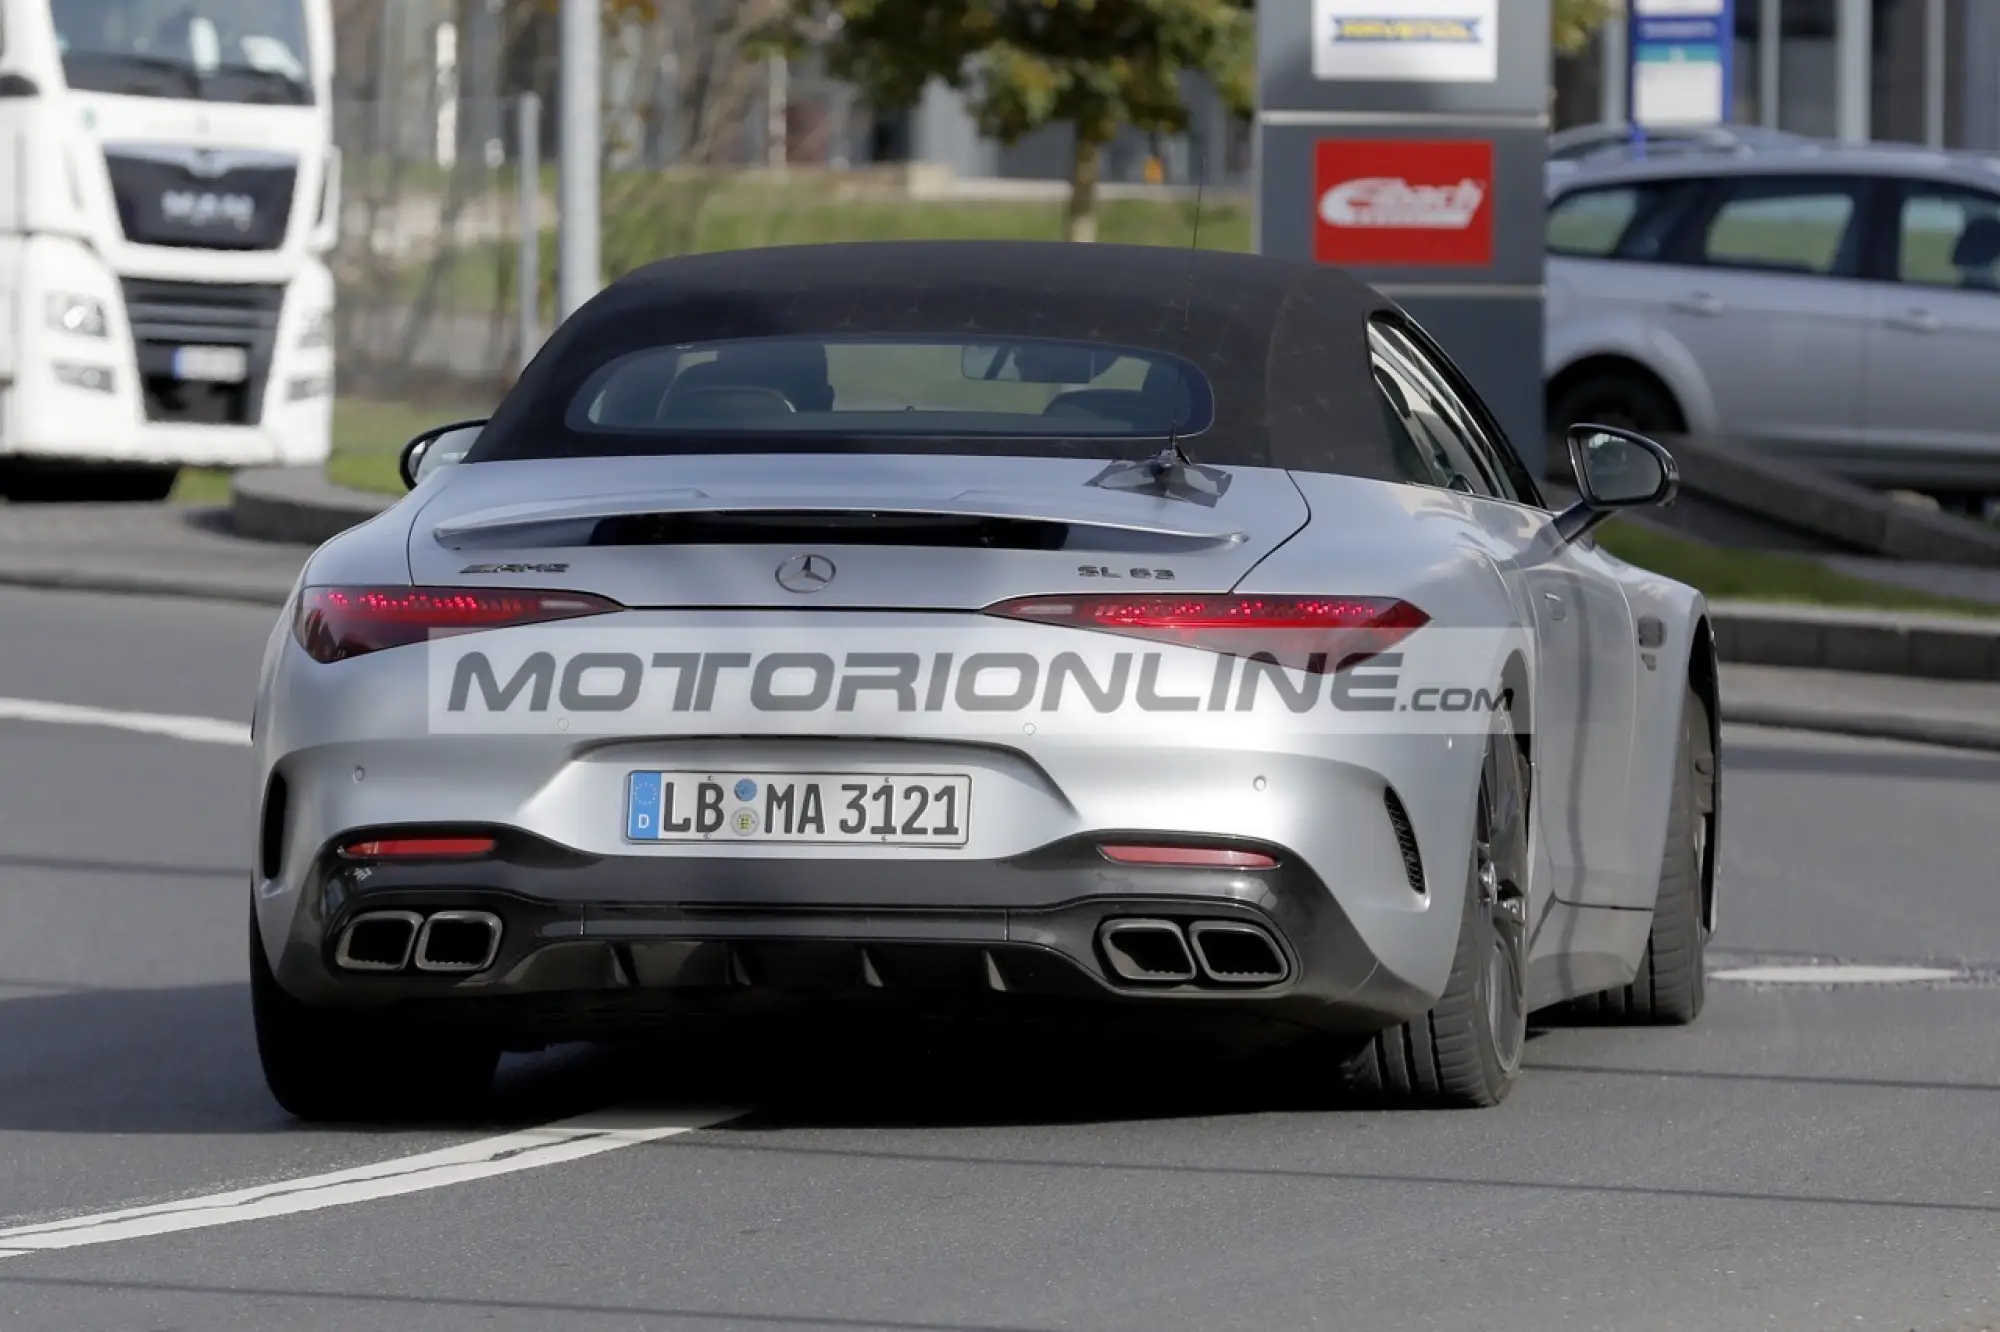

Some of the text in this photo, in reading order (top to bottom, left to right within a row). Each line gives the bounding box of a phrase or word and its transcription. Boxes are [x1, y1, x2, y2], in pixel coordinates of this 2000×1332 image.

[1077, 565, 1176, 581] SL 63
[638, 782, 960, 835] D LB MA 3121
